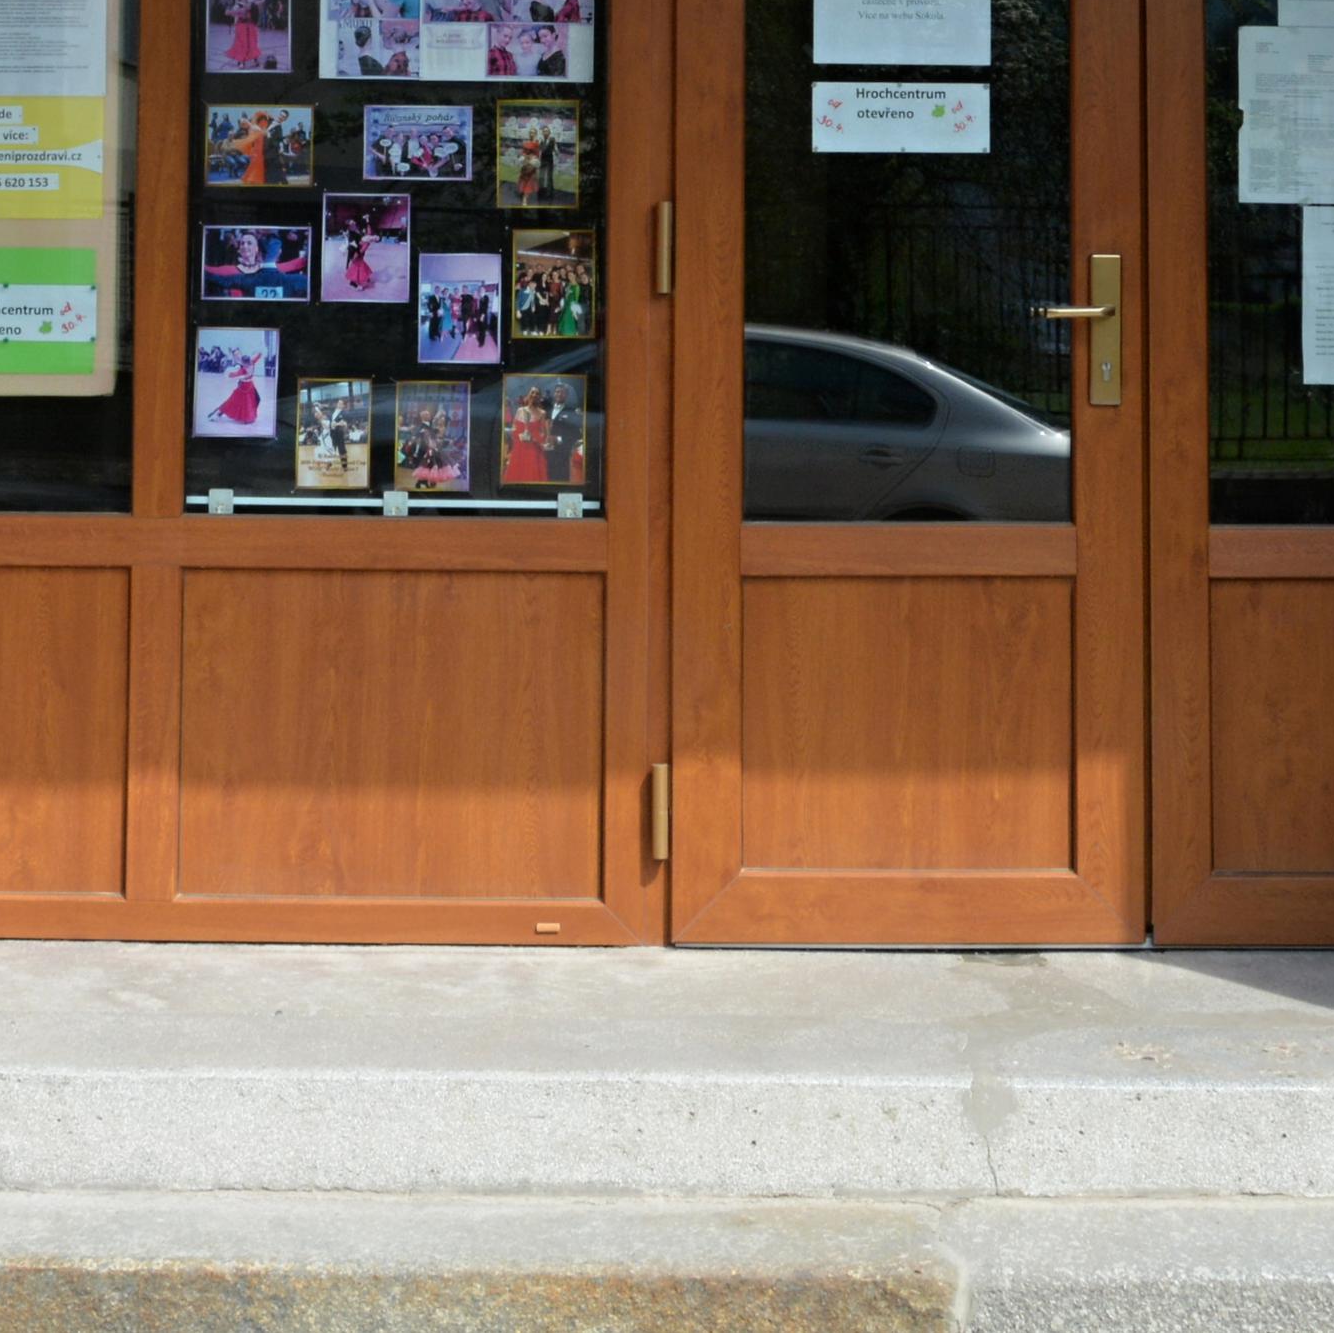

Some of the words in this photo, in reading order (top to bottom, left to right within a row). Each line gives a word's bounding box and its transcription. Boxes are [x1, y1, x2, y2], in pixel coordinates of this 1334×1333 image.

[855, 88, 947, 99] Hrochcentrum
[857, 107, 915, 119] otevřeno
[2, 129, 29, 141] více:
[4, 177, 26, 188] 620
[28, 177, 49, 188] 153
